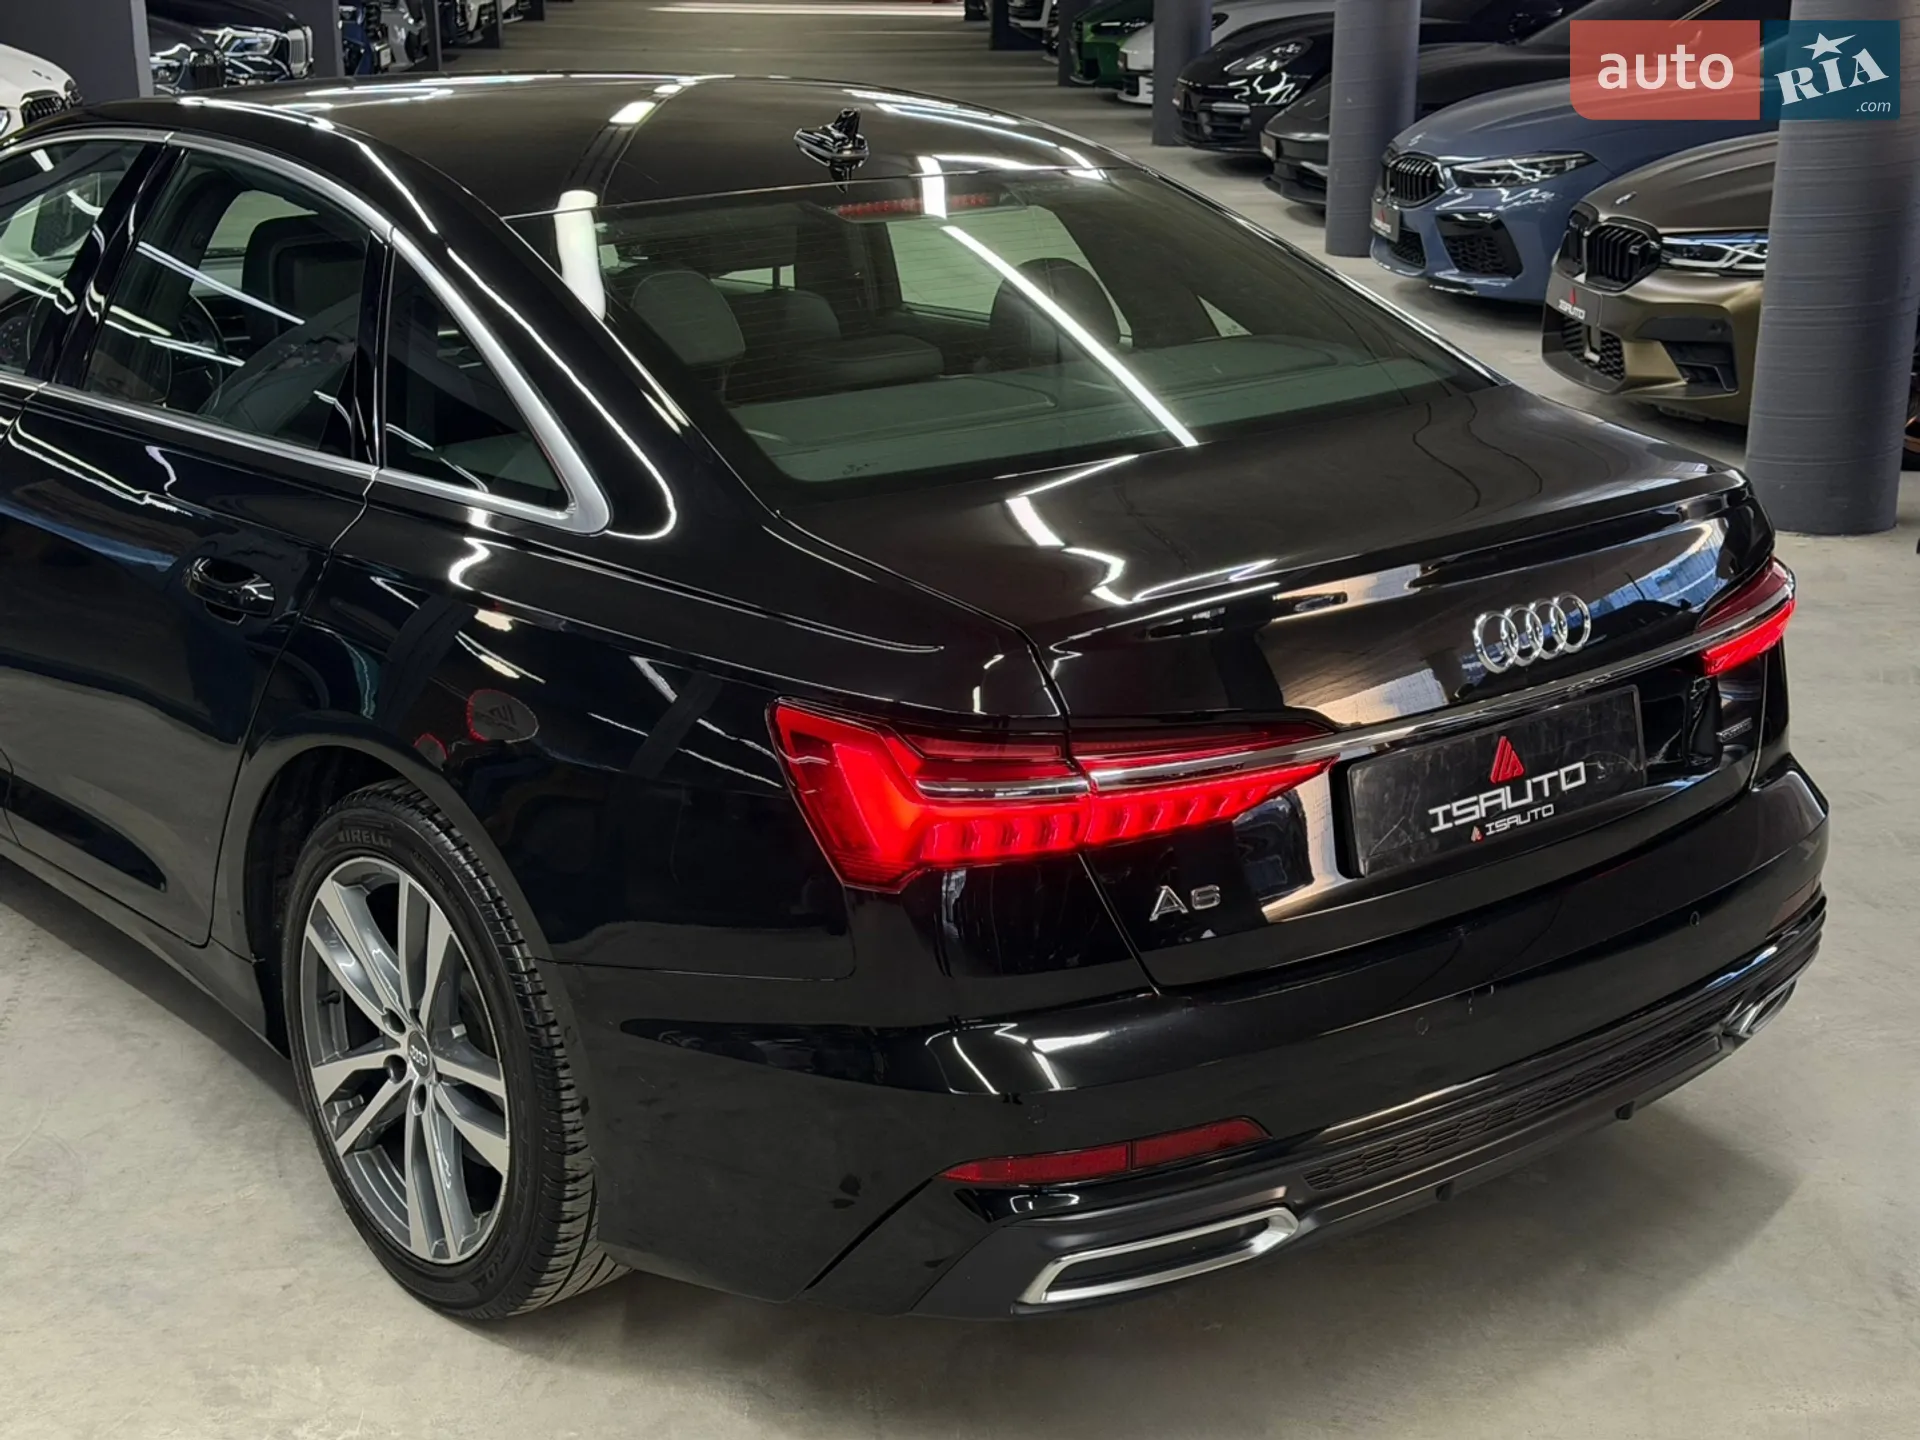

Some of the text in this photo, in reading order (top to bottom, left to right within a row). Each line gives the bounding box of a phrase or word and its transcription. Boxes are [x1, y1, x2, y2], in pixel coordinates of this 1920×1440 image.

[1428, 761, 1586, 833] ISAUTO
[1485, 803, 1555, 836] ISAUTO
[1149, 884, 1221, 922] A6
